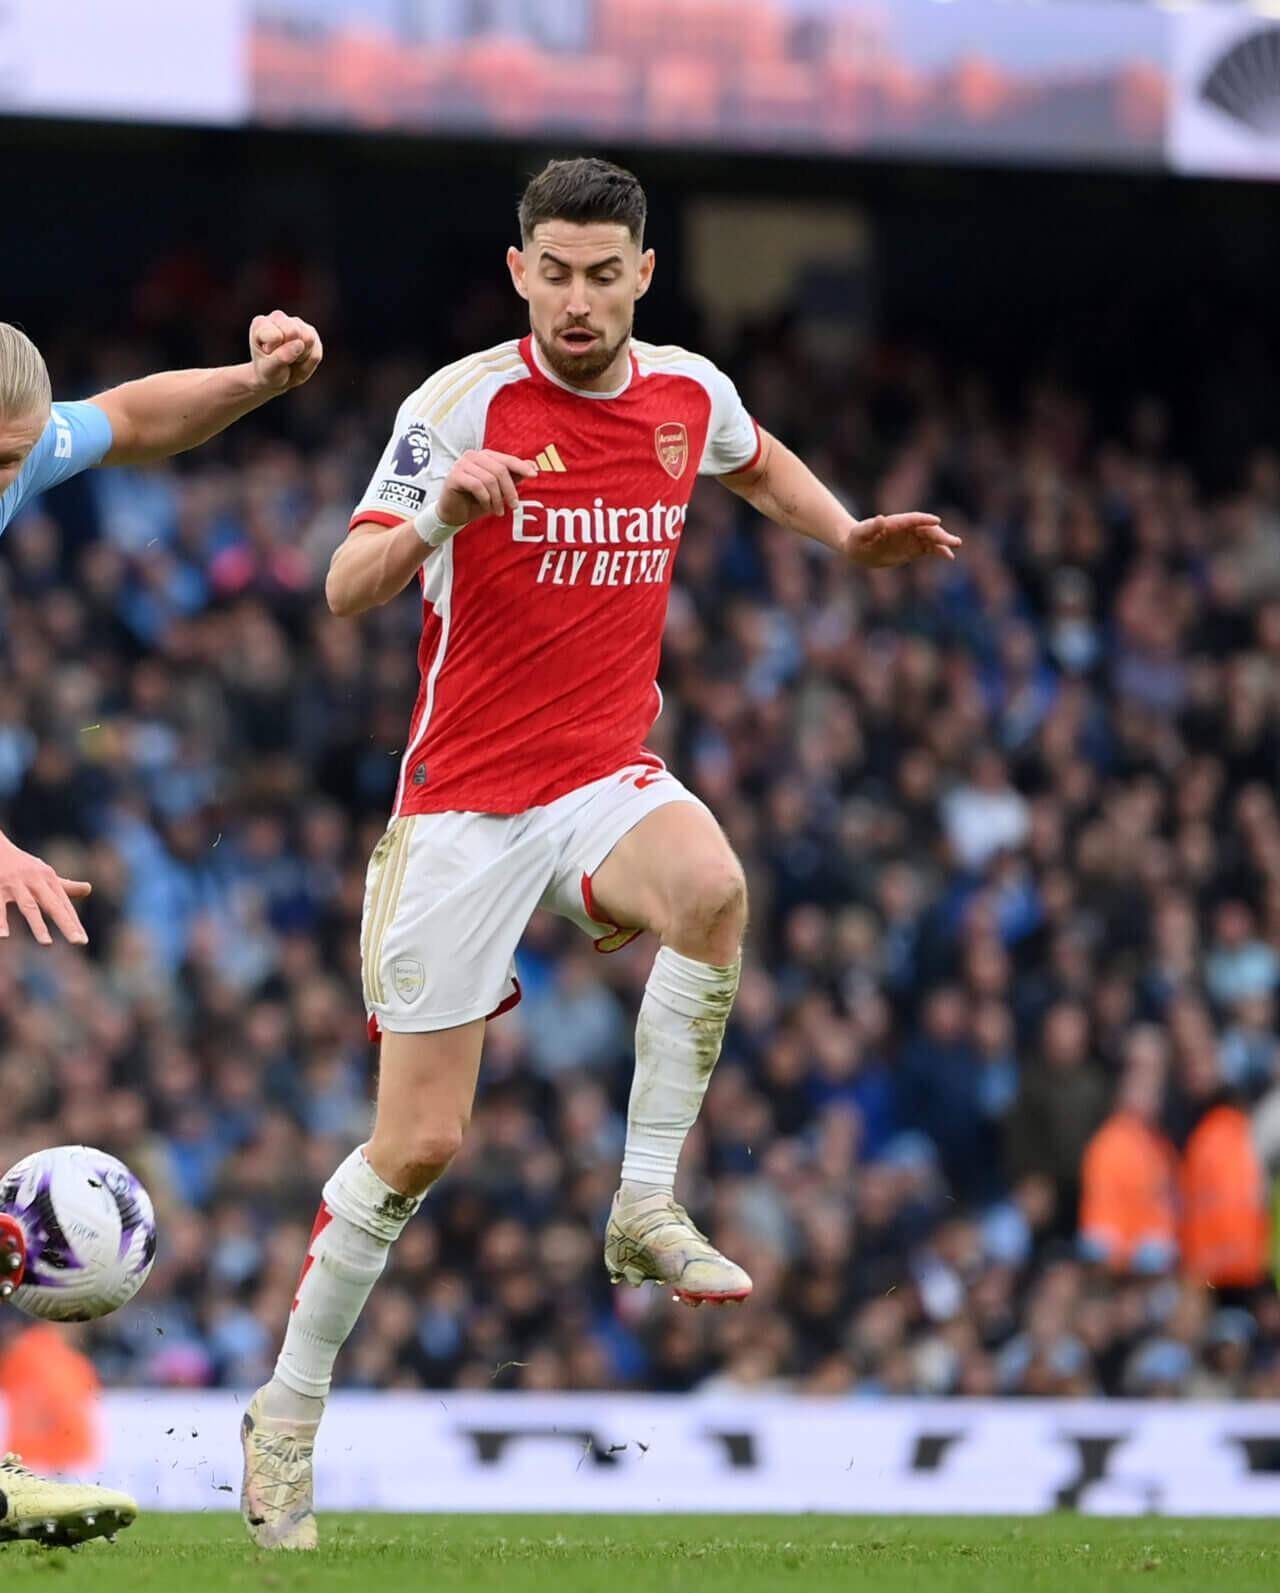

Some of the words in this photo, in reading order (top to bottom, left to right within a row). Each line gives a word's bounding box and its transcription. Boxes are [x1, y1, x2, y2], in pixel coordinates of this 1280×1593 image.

[387, 482, 421, 501] room
[536, 550, 587, 586] FLY
[590, 549, 671, 586] BETTER
